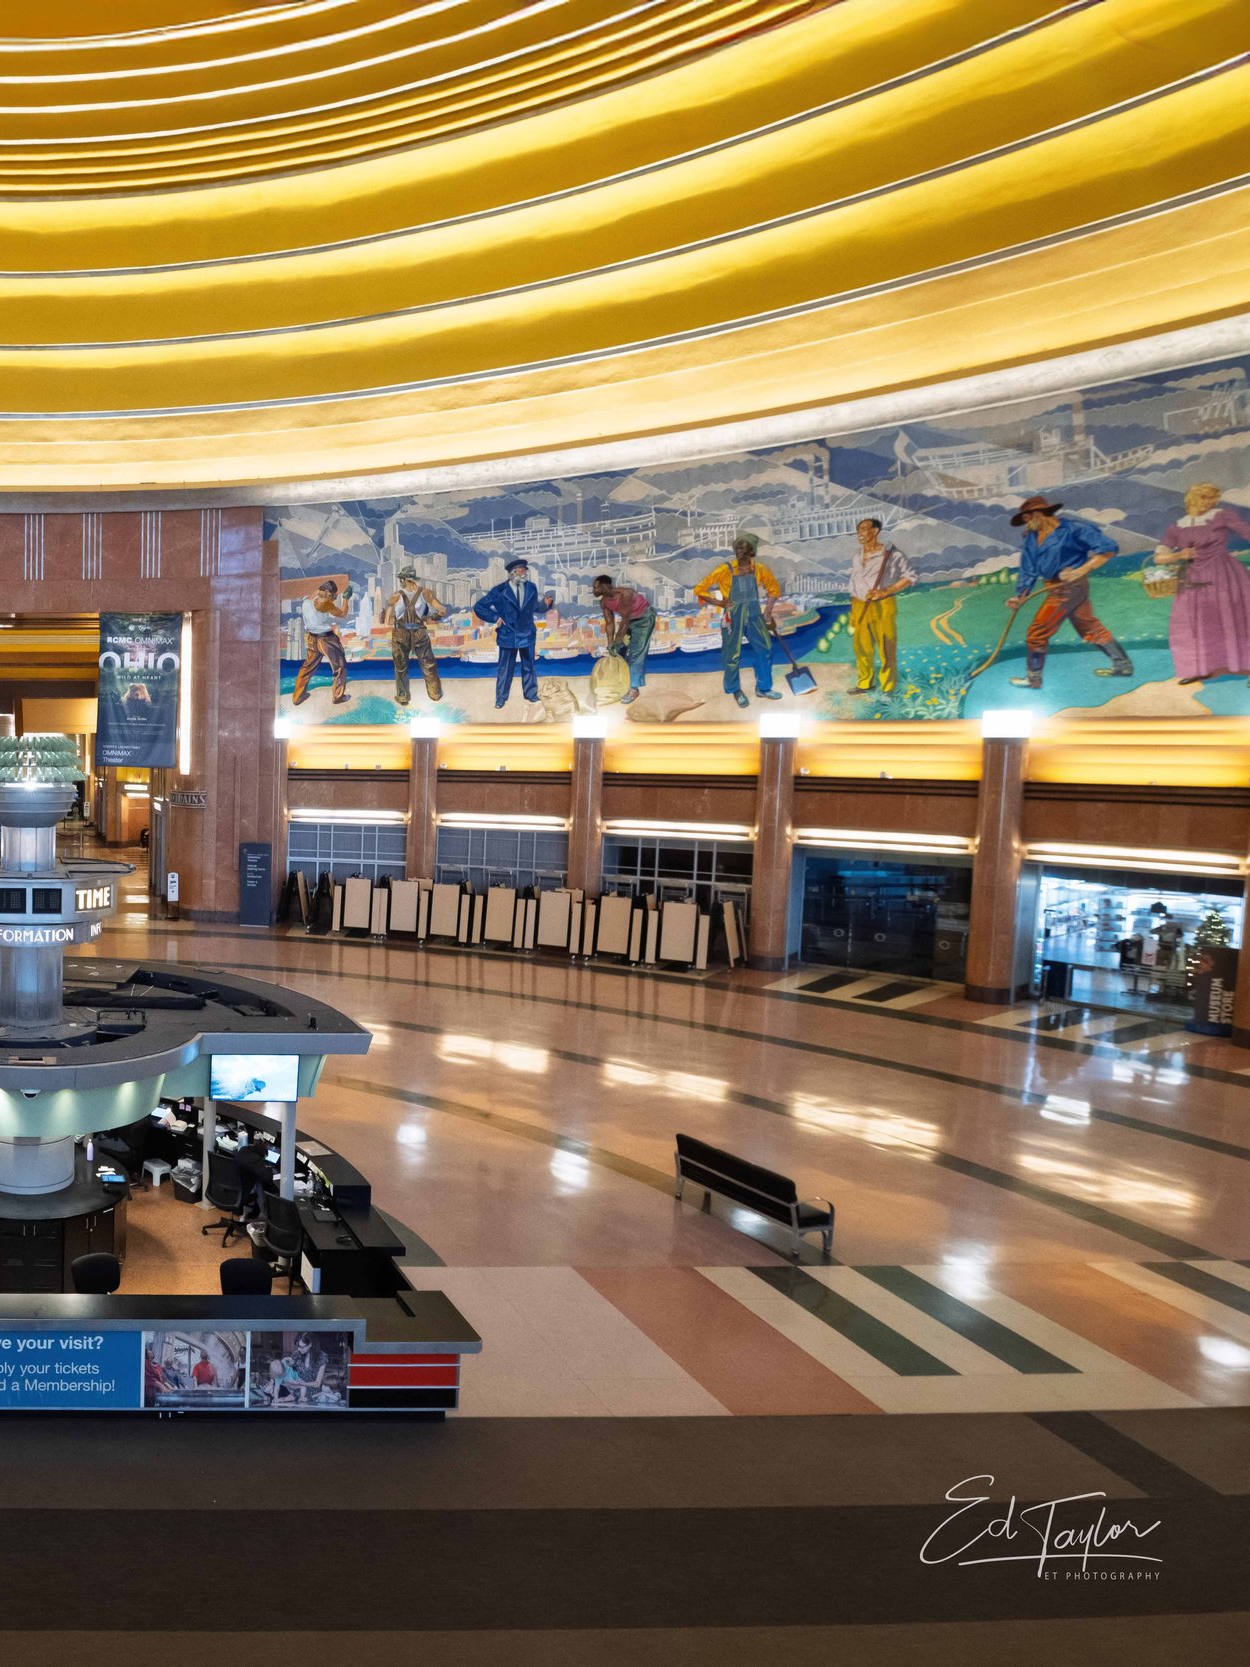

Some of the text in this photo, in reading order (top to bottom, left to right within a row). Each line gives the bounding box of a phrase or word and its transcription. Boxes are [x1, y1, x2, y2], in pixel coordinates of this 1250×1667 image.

[99, 651, 180, 674] OHIO
[75, 887, 110, 910] TIME
[1208, 978, 1223, 1023] MUSEUM
[1220, 991, 1235, 1024] STORE
[16, 1338, 54, 1352] your
[59, 1335, 104, 1350] visit?
[19, 1364, 51, 1377] your
[54, 1362, 100, 1375] tickets
[11, 1382, 20, 1392] a
[24, 1379, 115, 1394] Membership!
